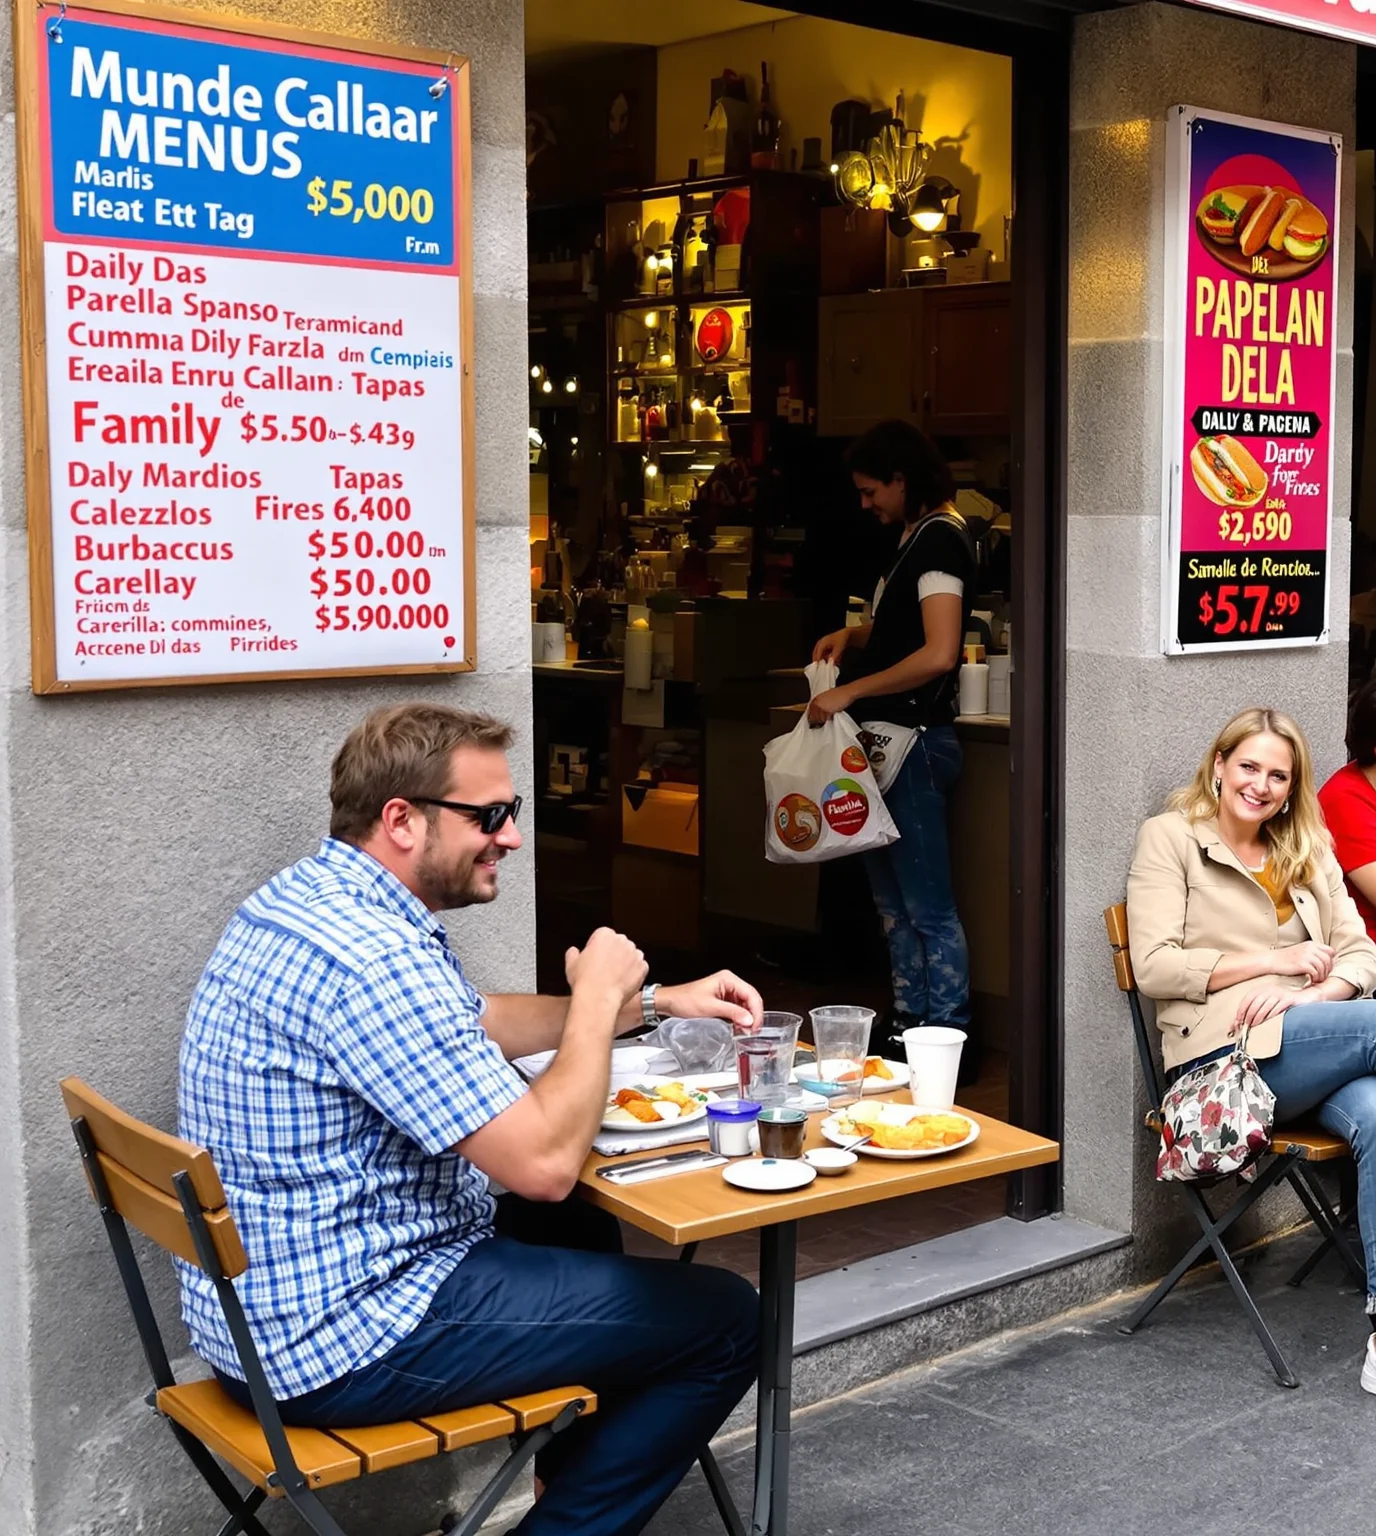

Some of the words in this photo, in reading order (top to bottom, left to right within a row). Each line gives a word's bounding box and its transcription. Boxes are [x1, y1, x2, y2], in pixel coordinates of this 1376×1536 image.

[71, 45, 263, 122] Munde
[275, 78, 438, 144] Callaar
[100, 110, 302, 179] MENUS
[75, 161, 154, 190] Marlis
[72, 191, 143, 223] Fleat
[155, 198, 196, 228] Ett
[204, 203, 254, 239] Tag
[306, 176, 434, 225] $5,000
[67, 251, 143, 286] Daily
[154, 257, 206, 284] Das
[67, 285, 172, 315] Parella
[184, 293, 278, 322] Spanso
[1195, 276, 1325, 347] PAPELAN
[192, 328, 241, 359] Dily
[249, 334, 324, 359] Farzla
[69, 356, 163, 384] Ereaila
[172, 361, 234, 387] Enru
[351, 372, 425, 401] Tapas
[1221, 343, 1295, 405] DELA
[221, 391, 244, 409] de
[73, 401, 221, 457] Family
[1242, 413, 1254, 432] &
[68, 462, 133, 493] Daly
[143, 462, 262, 489] Mardios
[329, 465, 404, 495] Tapas
[70, 500, 212, 526] Calezzlos
[255, 495, 325, 521] Fires
[75, 535, 234, 562] Burbaccus
[308, 529, 424, 562] $50.00
[74, 570, 197, 600] Carellay
[309, 566, 431, 599] $50.00
[1241, 557, 1257, 577] de
[171, 638, 200, 653] das
[230, 635, 298, 652] Pirrides
